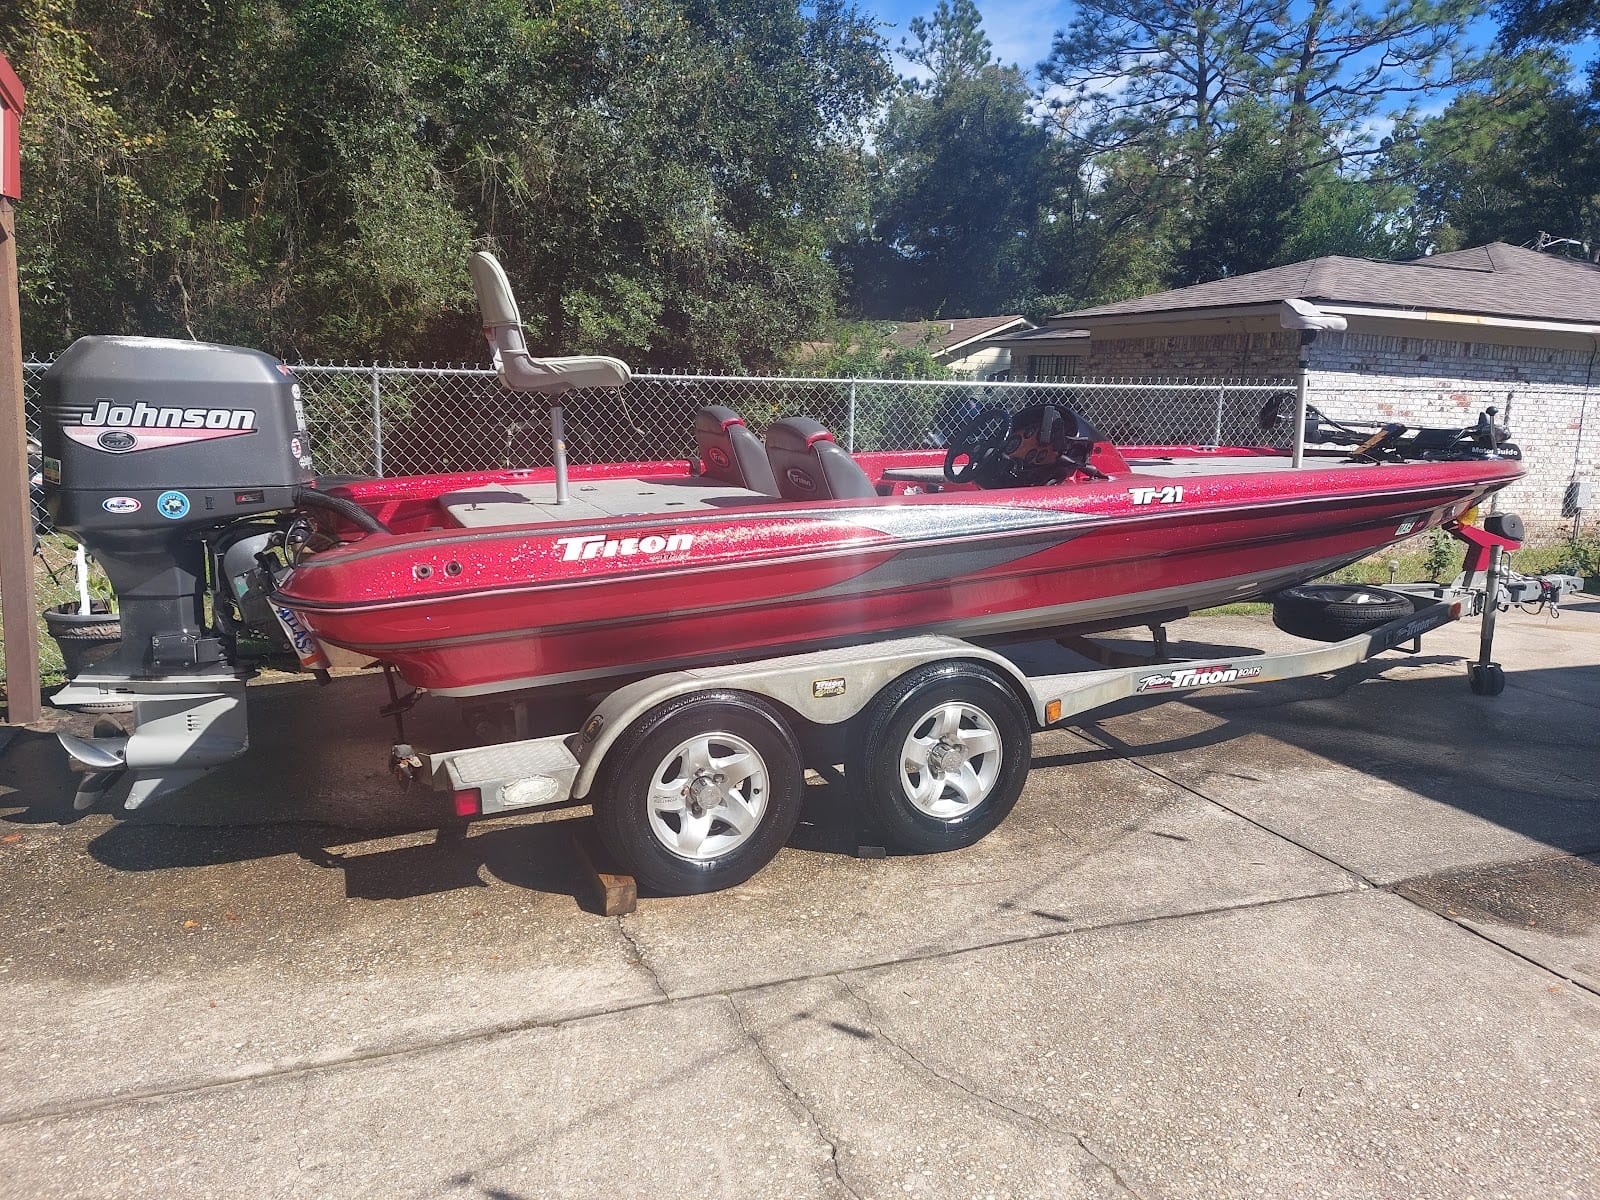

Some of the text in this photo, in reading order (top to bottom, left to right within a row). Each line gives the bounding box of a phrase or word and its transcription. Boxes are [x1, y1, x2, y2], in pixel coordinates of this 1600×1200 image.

[81, 400, 257, 430] Johnson
[556, 533, 695, 562] Triton
[1170, 668, 1239, 689] Triton
[1237, 666, 1262, 677] BOATS
